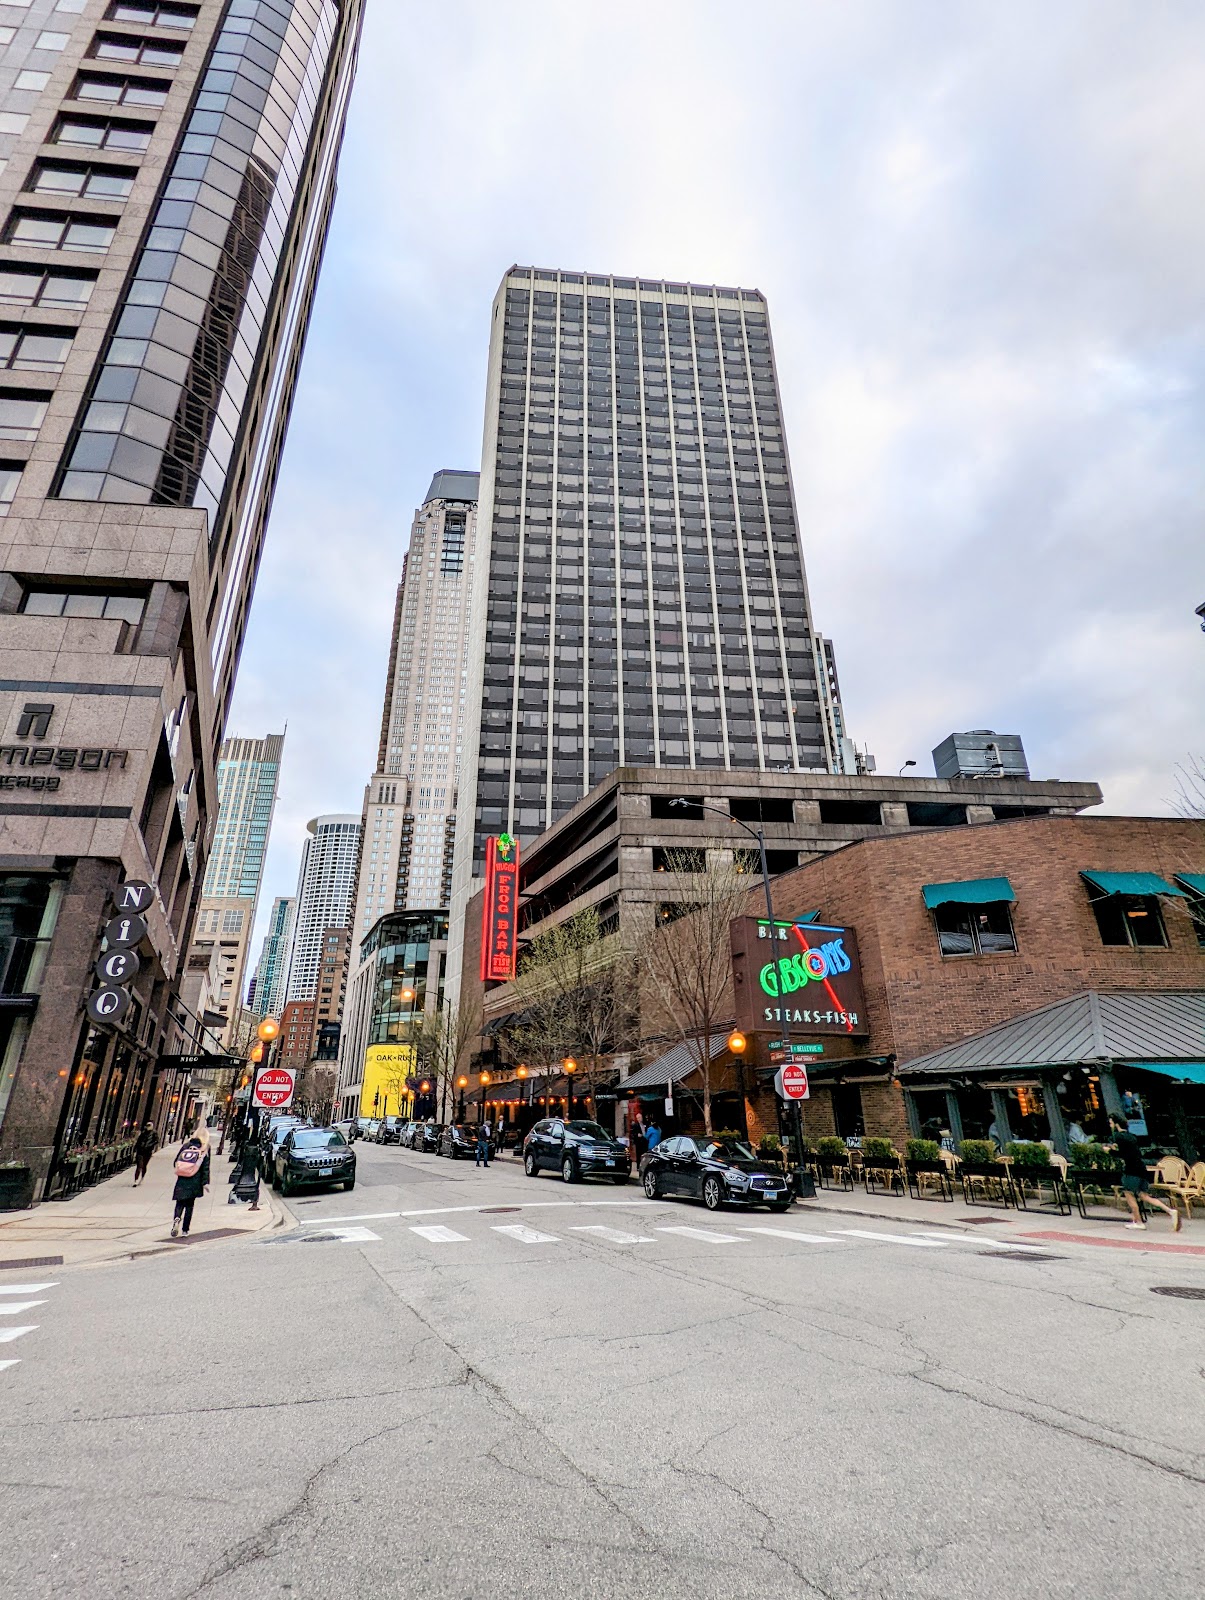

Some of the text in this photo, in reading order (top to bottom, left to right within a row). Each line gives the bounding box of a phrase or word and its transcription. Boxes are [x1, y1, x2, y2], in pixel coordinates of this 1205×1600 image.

[498, 876, 511, 913] FROG
[496, 920, 510, 950] BAR
[759, 938, 851, 997] GIBSONS
[262, 1075, 272, 1083] DO
